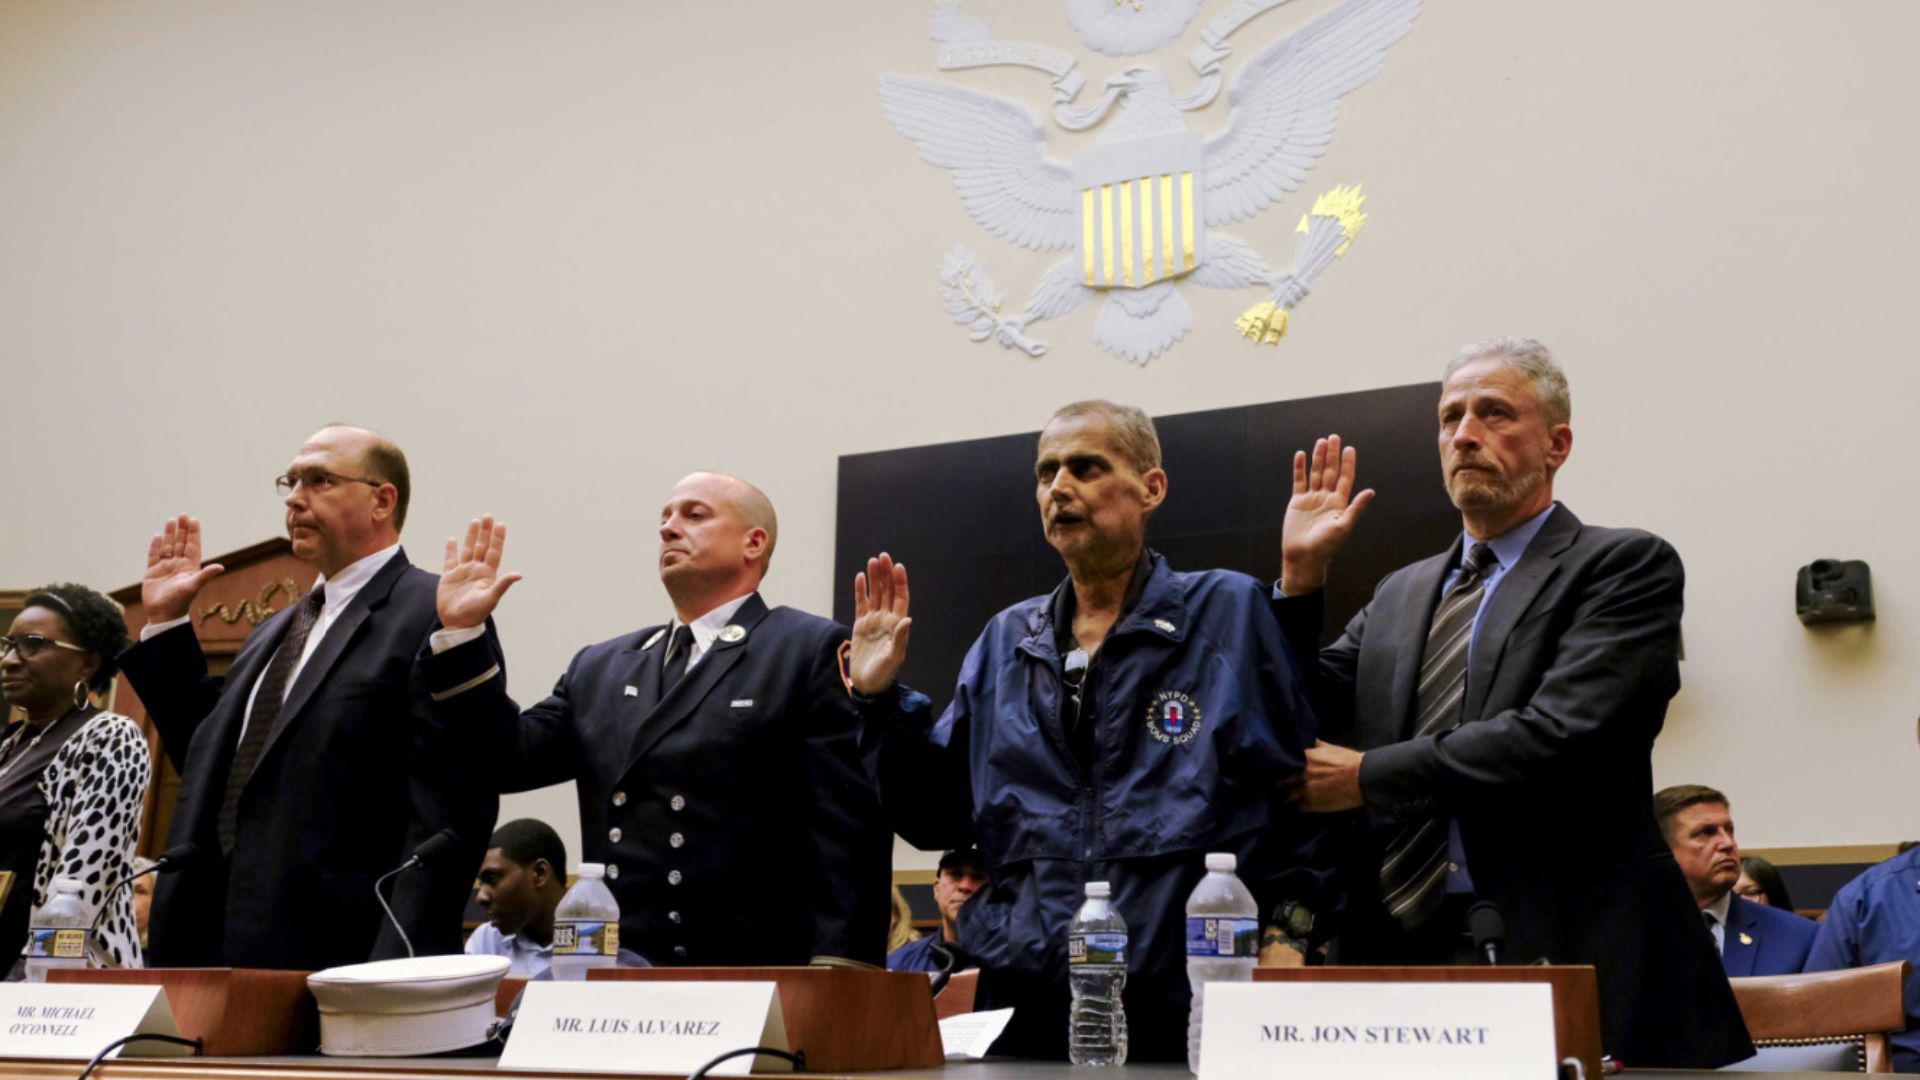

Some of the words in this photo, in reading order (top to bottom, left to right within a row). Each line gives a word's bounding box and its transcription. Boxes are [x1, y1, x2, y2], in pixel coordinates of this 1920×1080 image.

[1159, 691, 1189, 703] NYPD
[1146, 720, 1170, 743] BOMB
[1172, 720, 1201, 745] SQUAD
[17, 1005, 37, 1018] MR.
[41, 1006, 96, 1020] MICHAEL
[9, 1023, 79, 1036] O'CONNELL
[552, 1017, 583, 1033] MR.
[588, 1018, 630, 1034] LUIS
[632, 1019, 721, 1036] ALVAREZ
[1260, 1025, 1305, 1043] MR.
[1312, 1025, 1357, 1043] JON
[1364, 1026, 1490, 1045] STEWART
